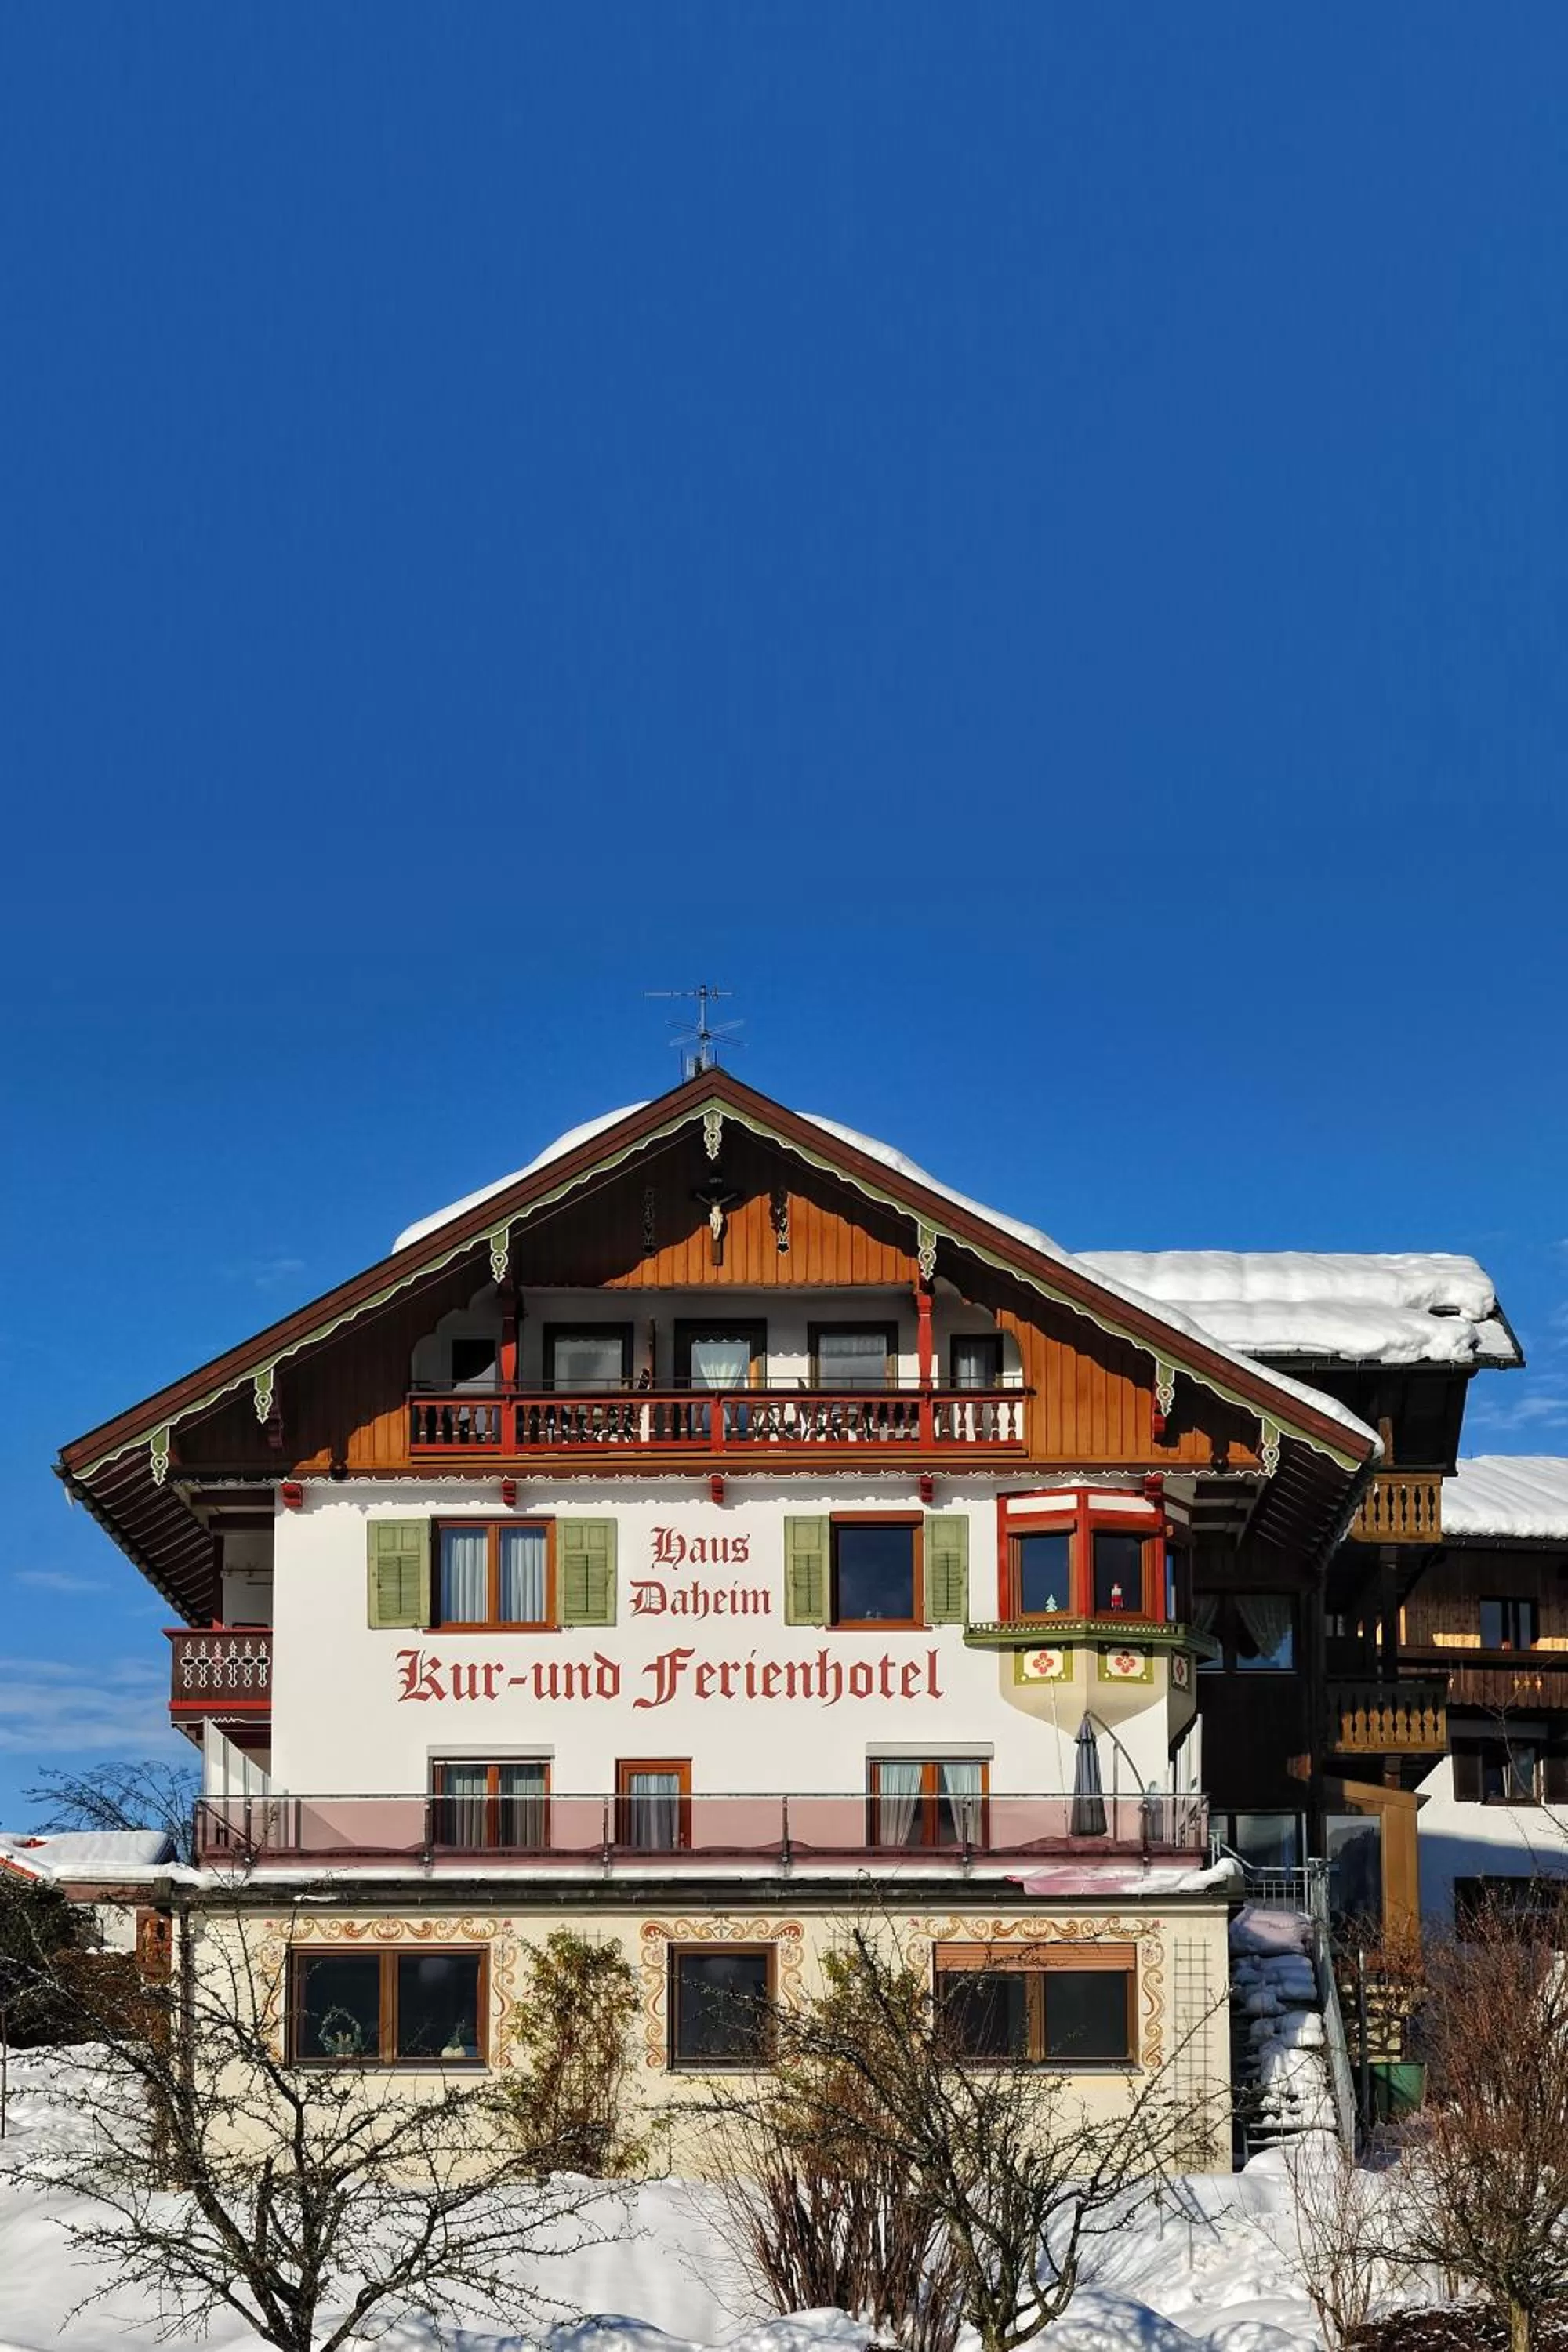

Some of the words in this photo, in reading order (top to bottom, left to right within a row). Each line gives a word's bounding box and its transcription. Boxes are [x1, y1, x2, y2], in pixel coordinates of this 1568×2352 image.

[651, 1527, 750, 1570] Haus
[629, 1580, 772, 1621] Daheim
[633, 1647, 946, 1709] Ferienhotel
